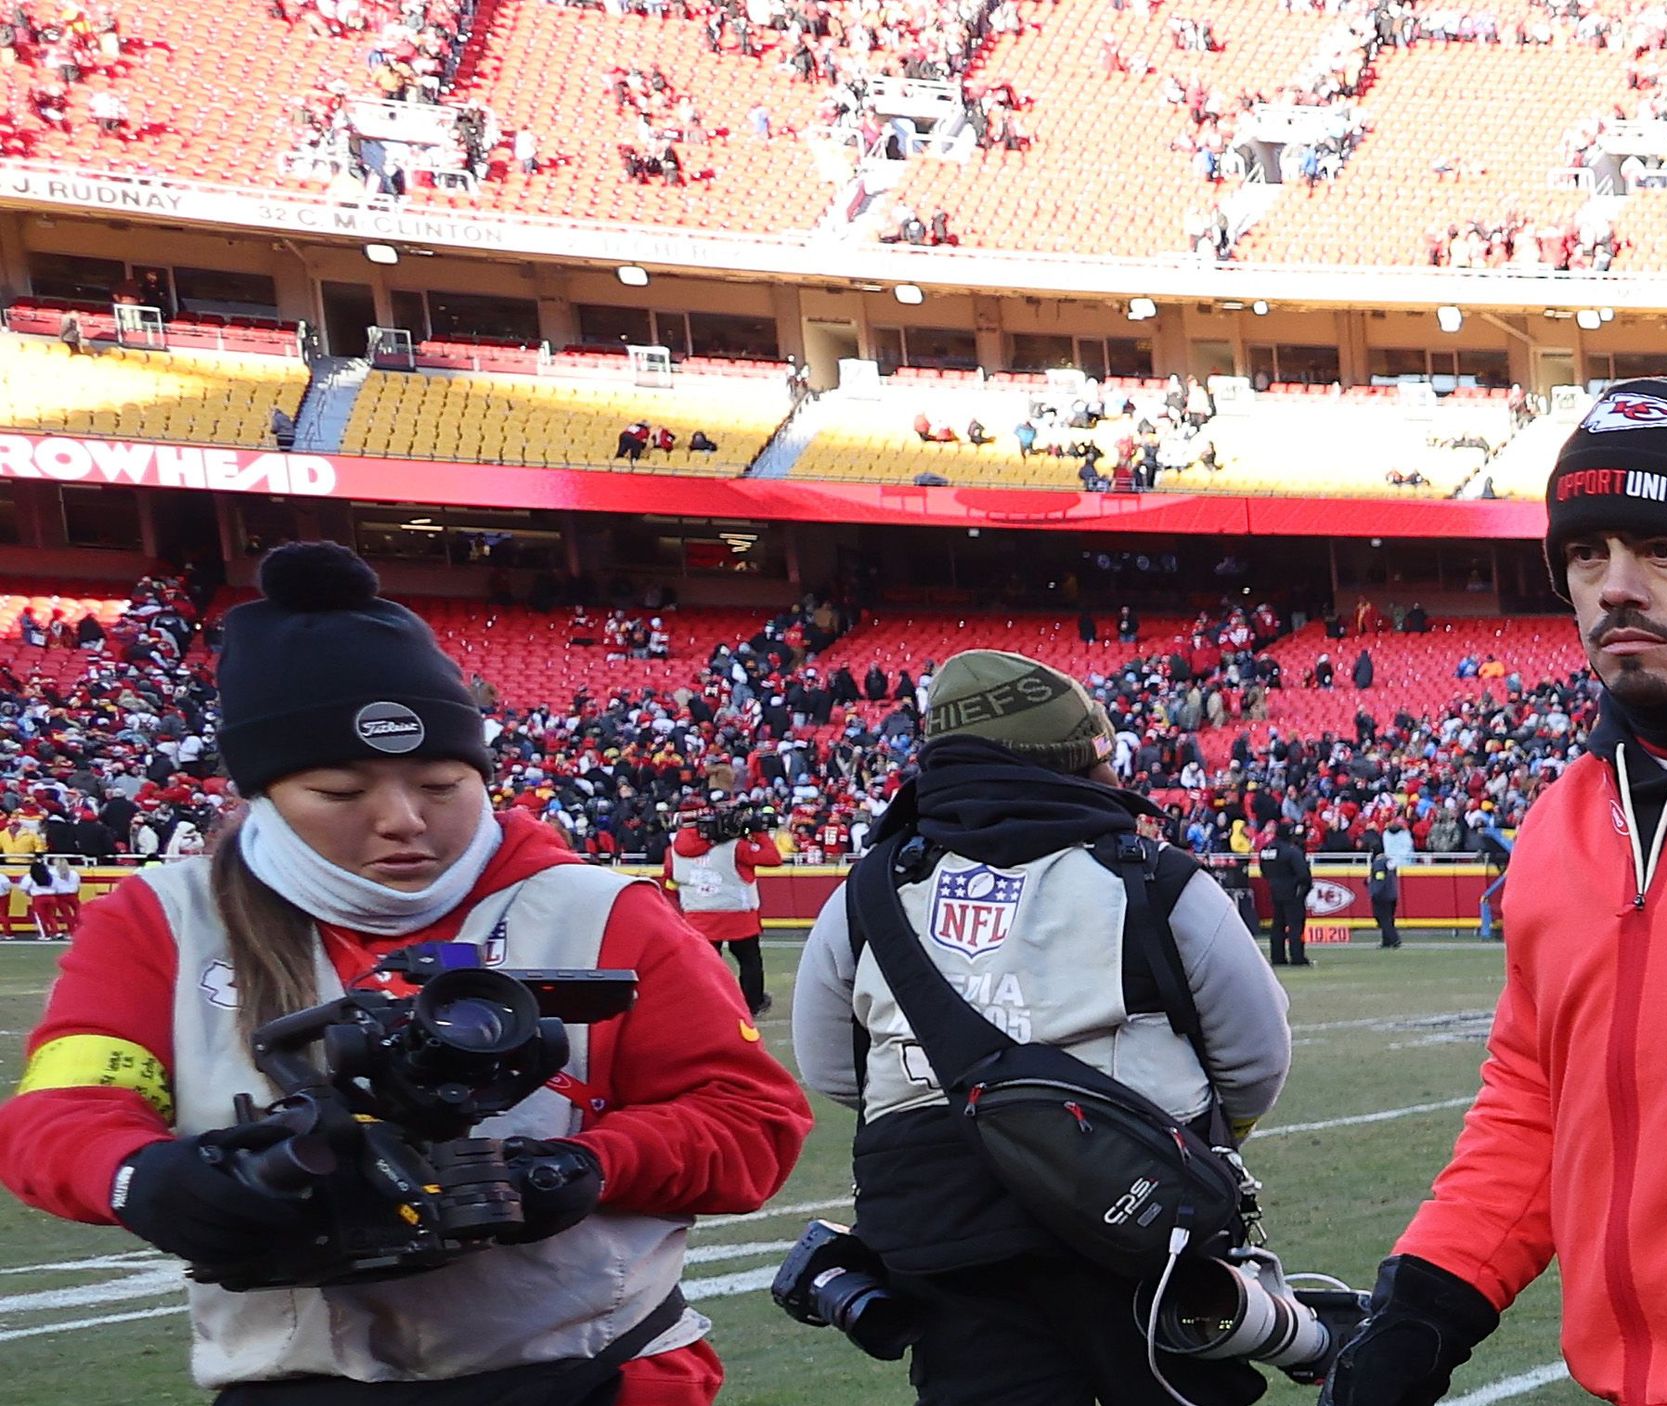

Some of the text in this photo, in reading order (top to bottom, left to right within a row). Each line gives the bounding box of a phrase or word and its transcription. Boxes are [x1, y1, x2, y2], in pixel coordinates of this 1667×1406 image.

[48, 180, 182, 212] RUDNAY
[939, 902, 1008, 947] NFL
[1103, 1177, 1152, 1225] CPS
